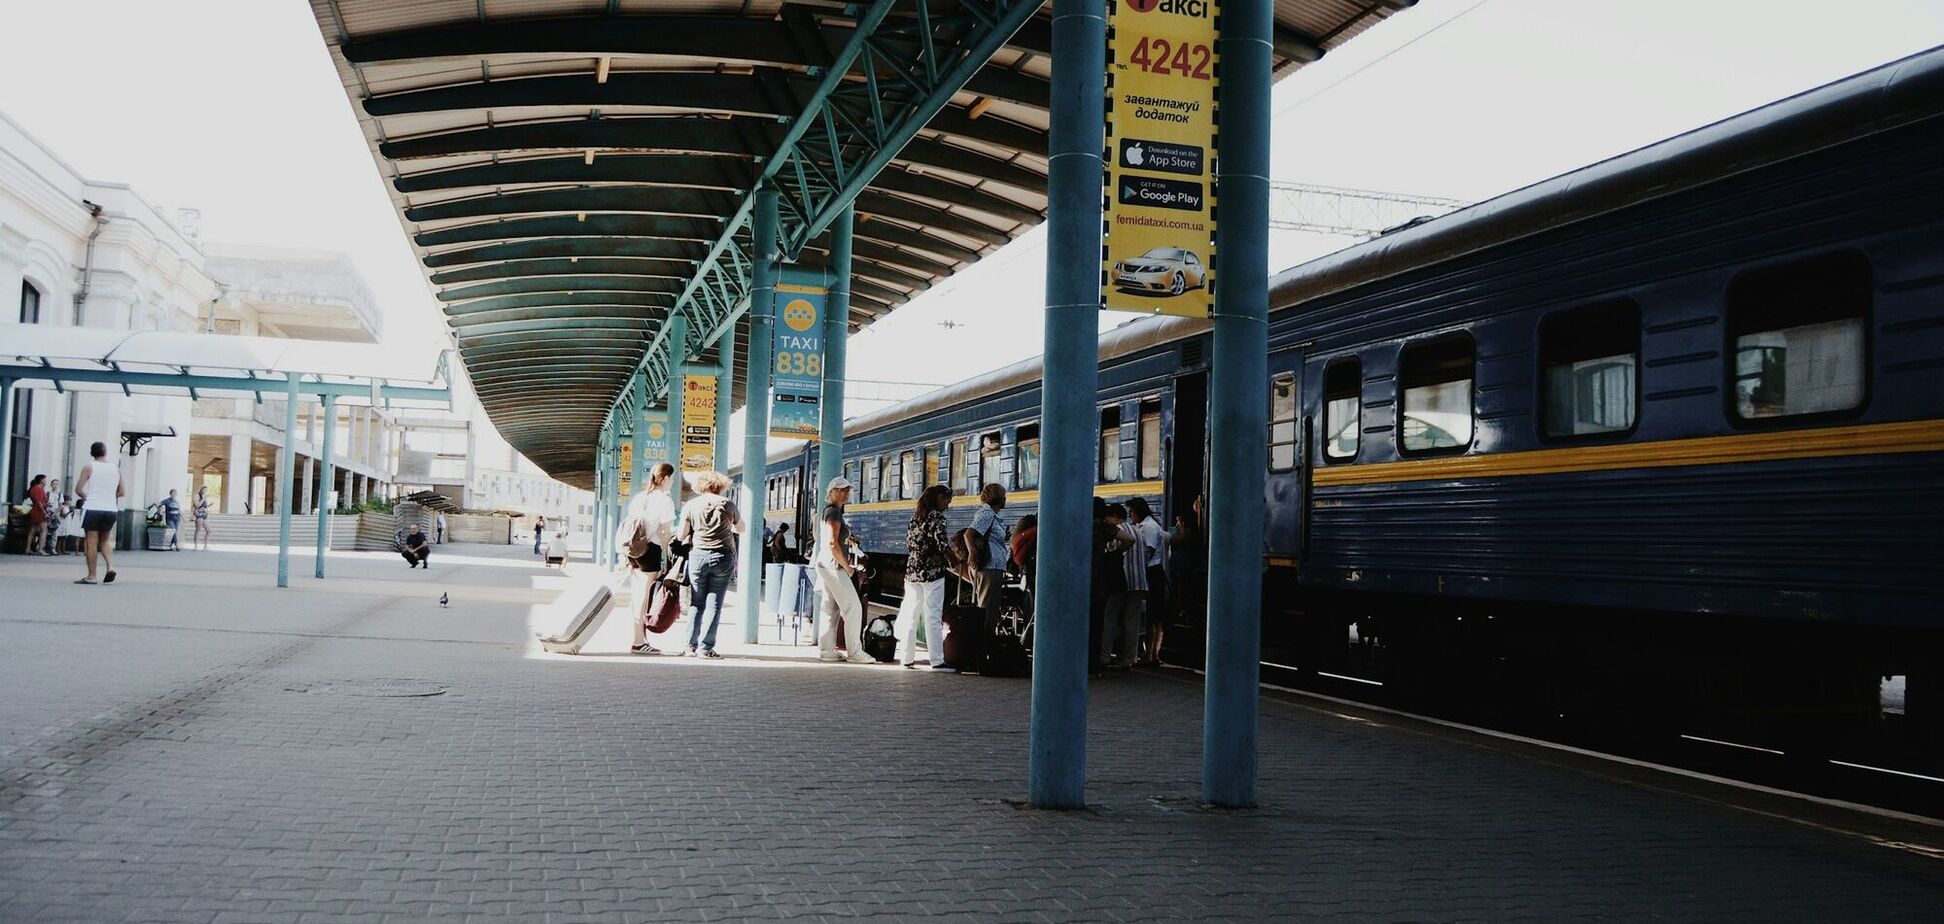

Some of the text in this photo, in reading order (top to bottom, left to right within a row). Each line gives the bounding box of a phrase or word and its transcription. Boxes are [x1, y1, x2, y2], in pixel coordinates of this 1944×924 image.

[1130, 36, 1211, 81] 4242
[1124, 94, 1200, 113] завантажуй
[1135, 106, 1190, 123] додаток
[1148, 146, 1178, 156] Download
[1188, 150, 1199, 158] the
[1149, 154, 1196, 169] App Store
[1140, 188, 1199, 206] Google Play
[1116, 214, 1204, 231] femidataxi.com.ua
[780, 335, 818, 350] TAXI
[776, 351, 821, 377] 838
[690, 398, 714, 408] 4242
[646, 440, 665, 448] TAXI
